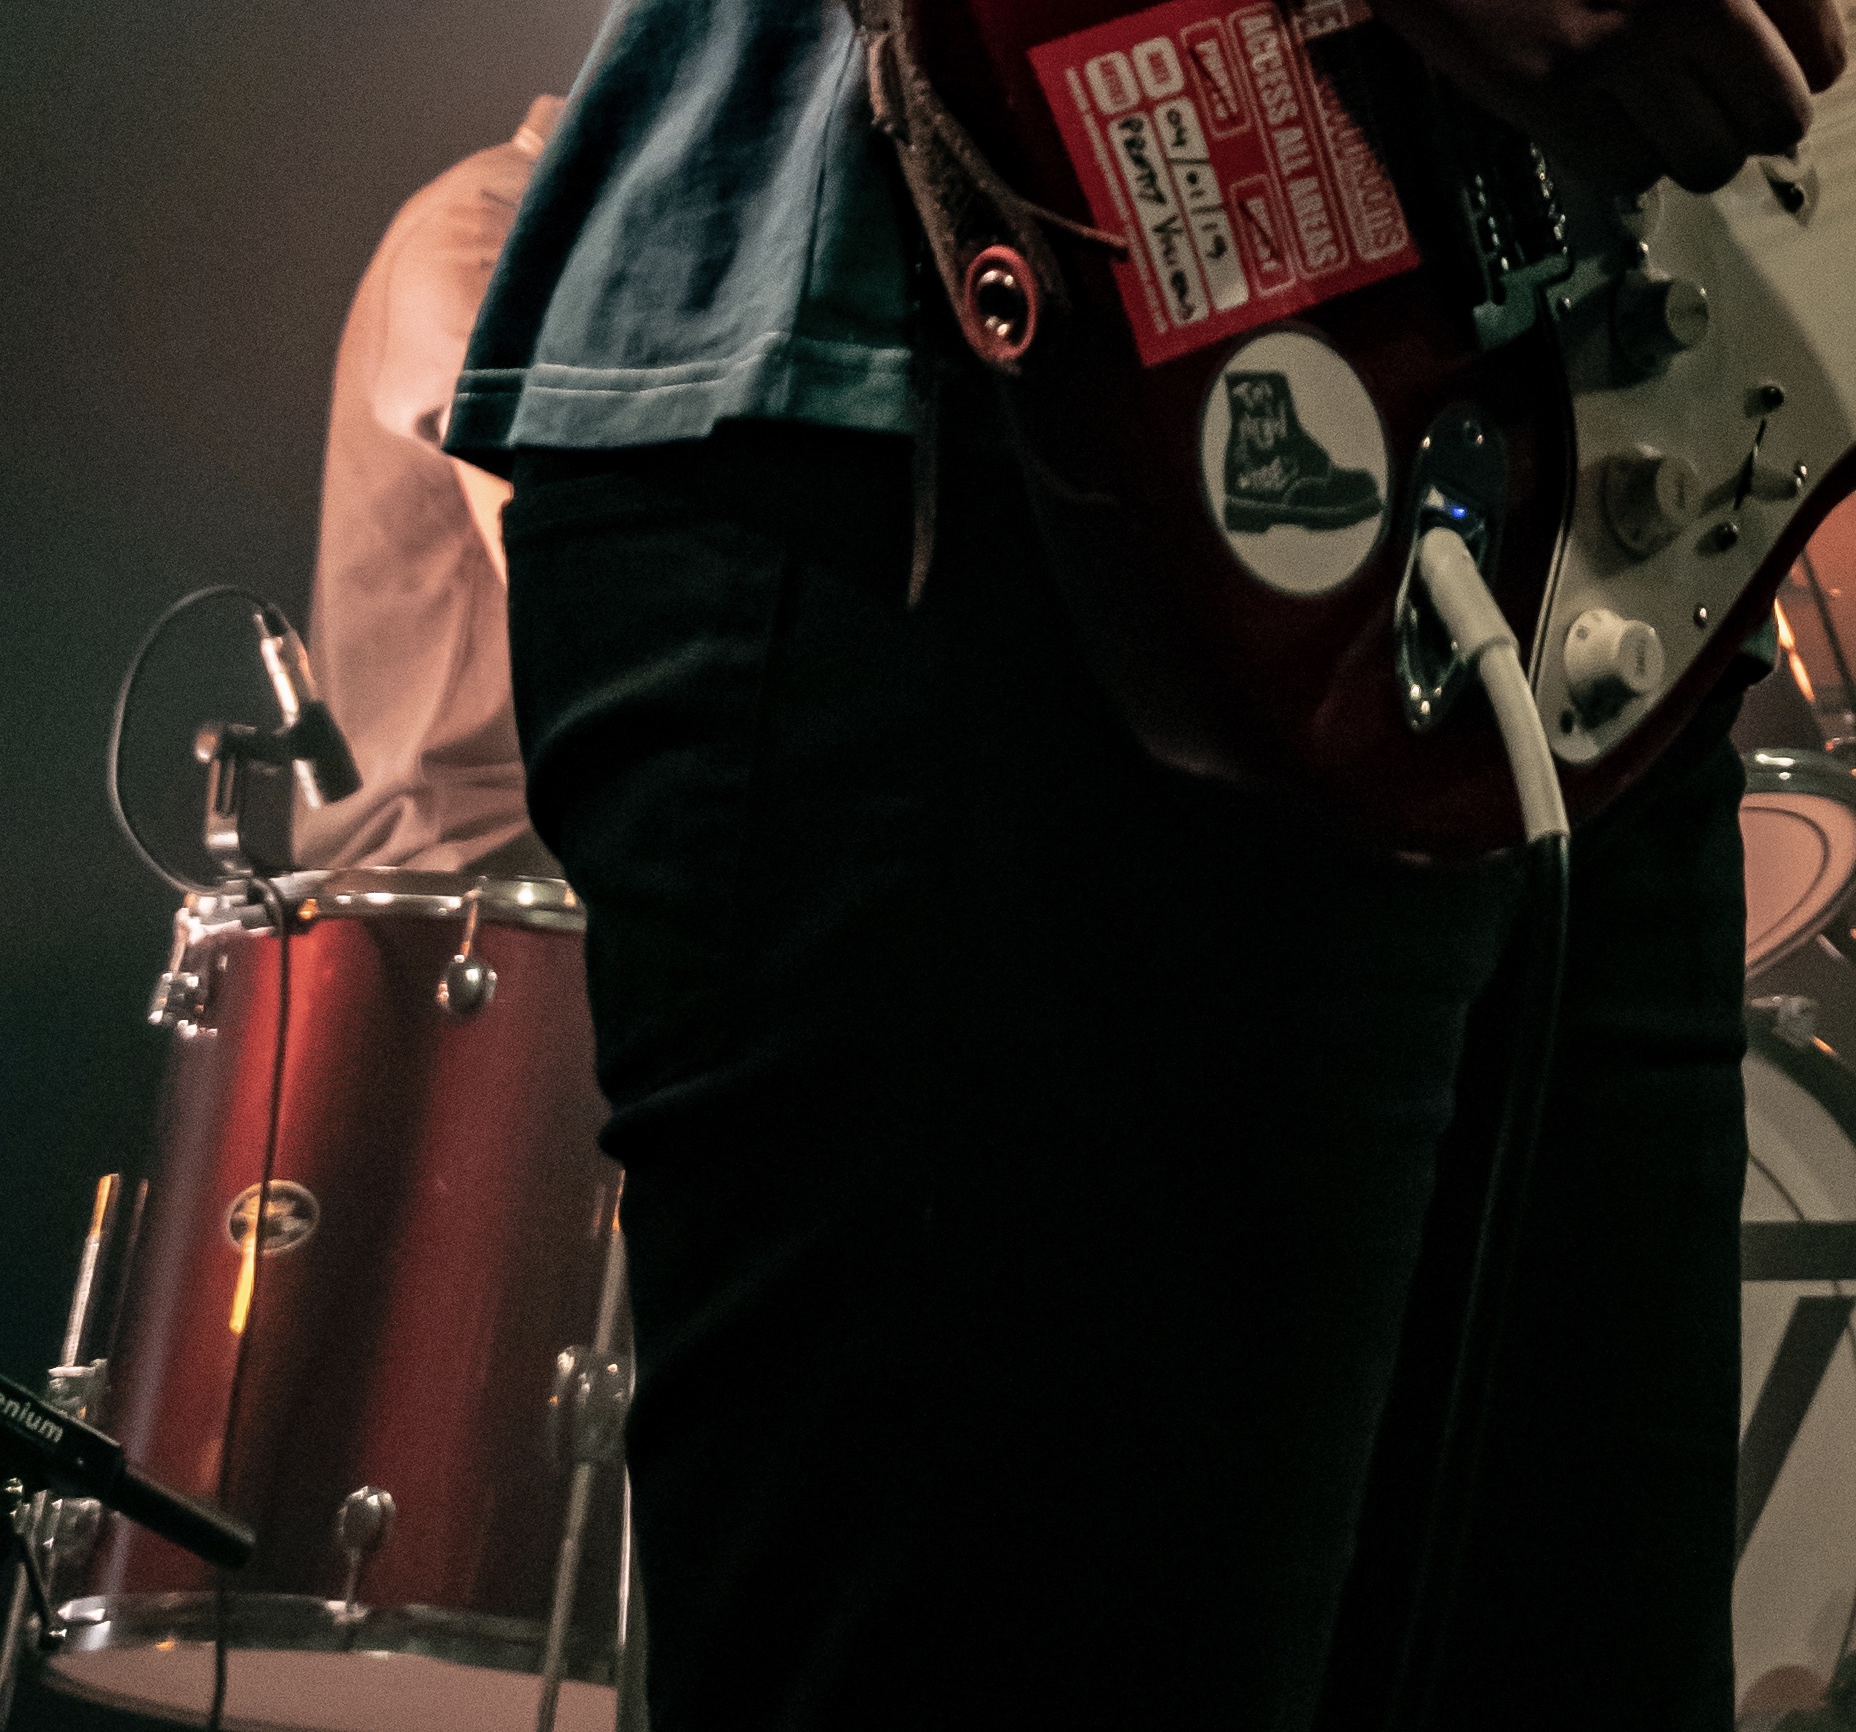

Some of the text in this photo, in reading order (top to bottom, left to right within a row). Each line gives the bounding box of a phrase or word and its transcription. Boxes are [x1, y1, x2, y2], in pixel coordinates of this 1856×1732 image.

[1239, 13, 1299, 125] ACCESS
[1272, 126, 1314, 177] ALL
[1285, 175, 1339, 268] AREAS
